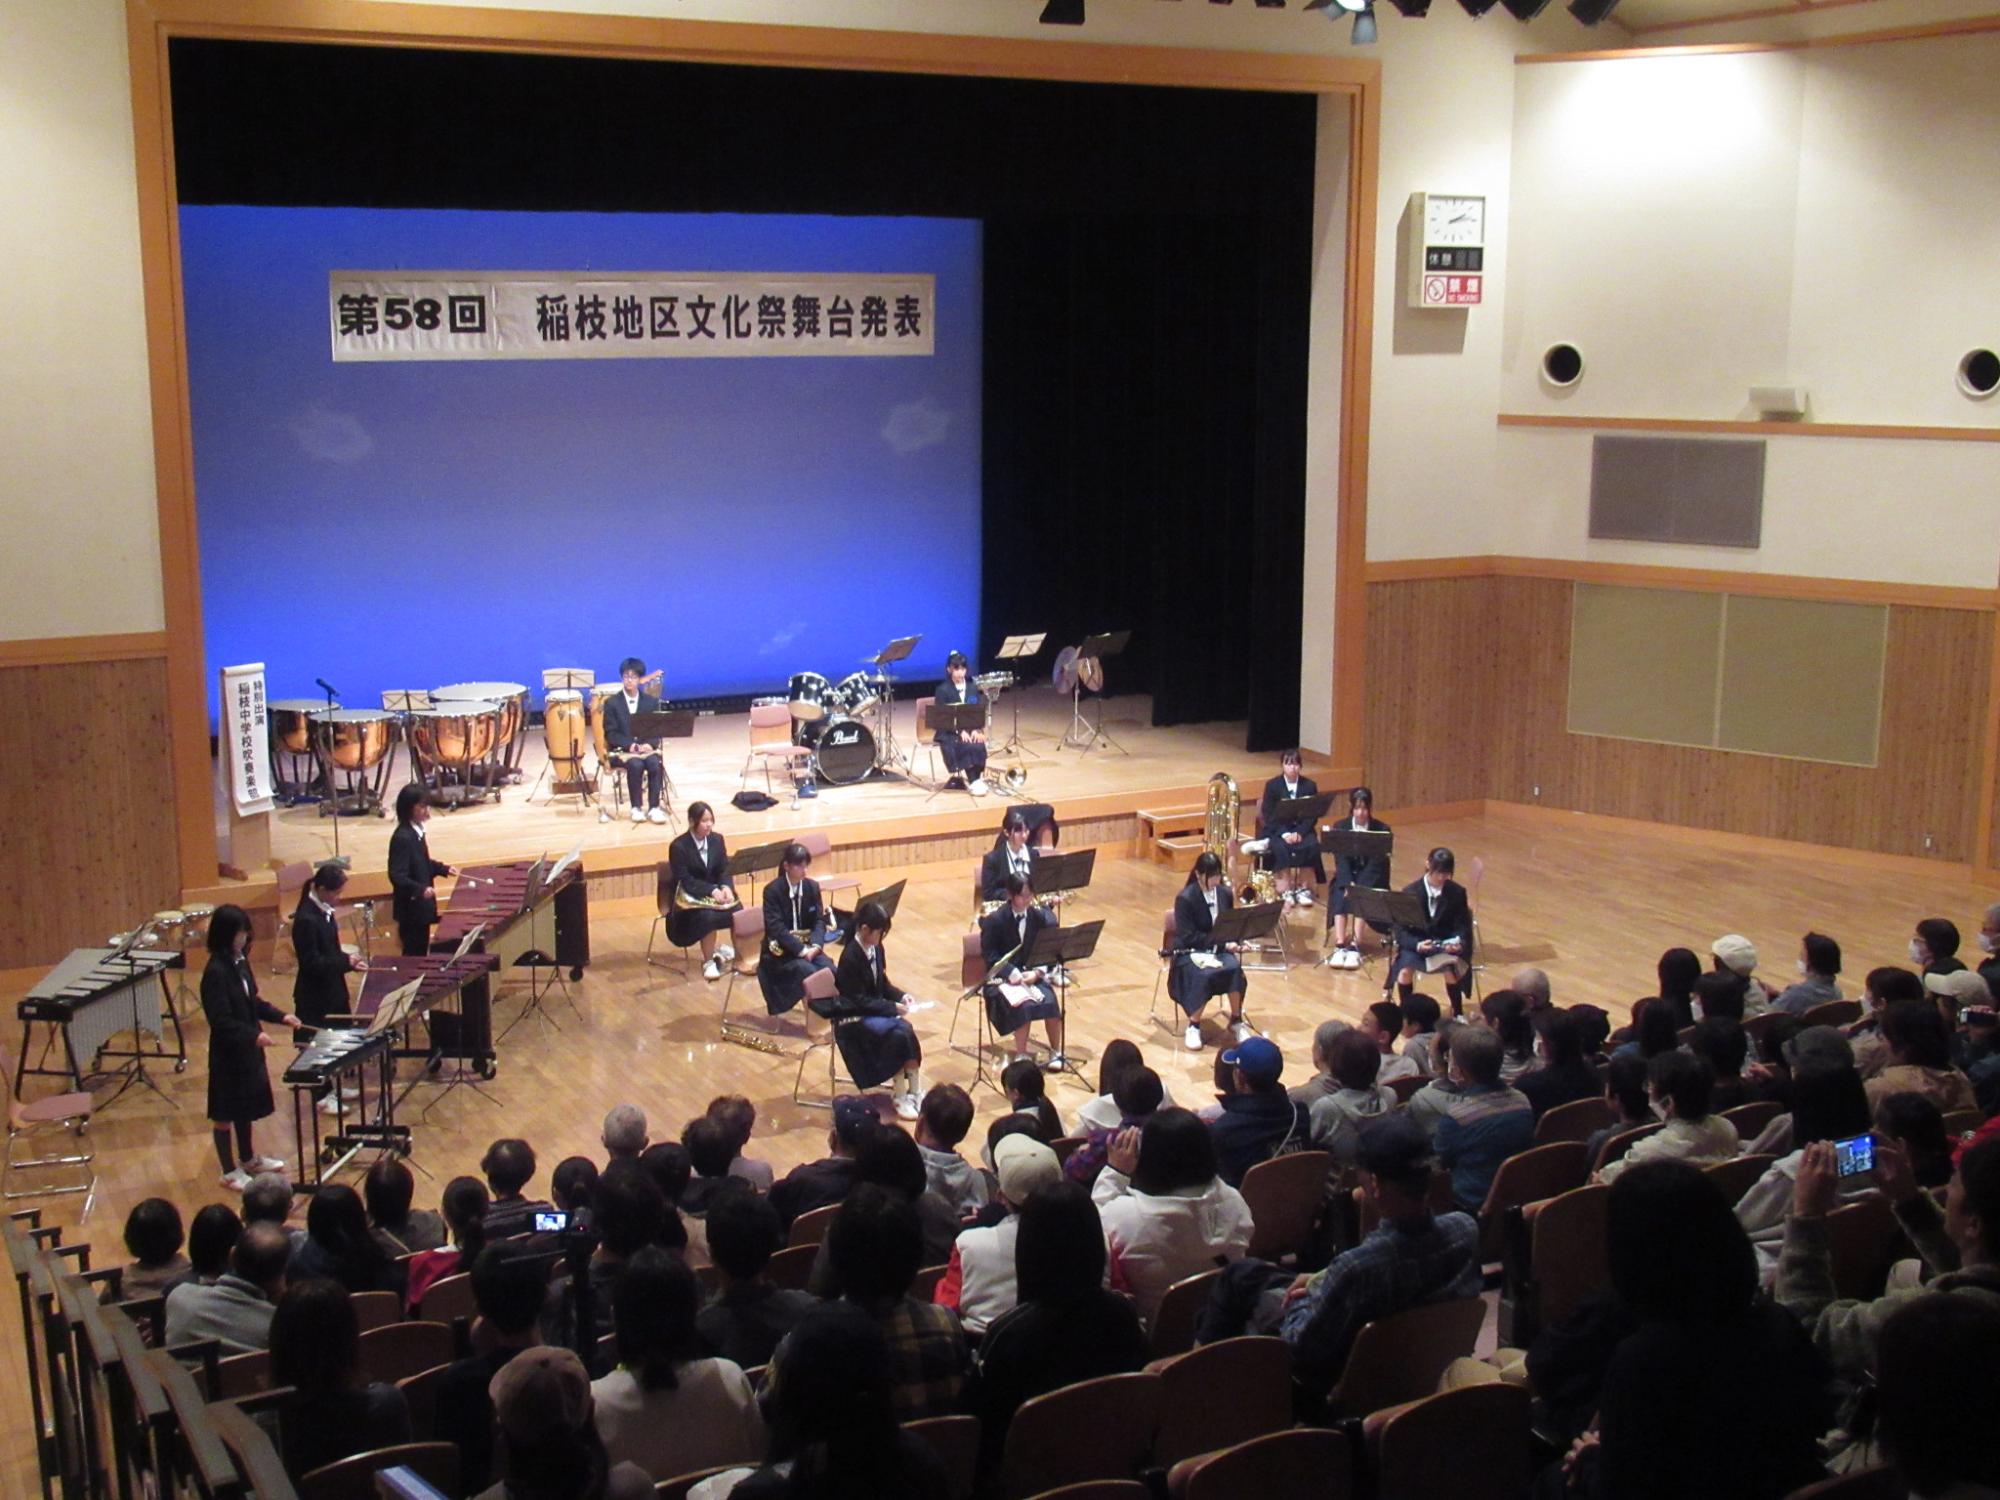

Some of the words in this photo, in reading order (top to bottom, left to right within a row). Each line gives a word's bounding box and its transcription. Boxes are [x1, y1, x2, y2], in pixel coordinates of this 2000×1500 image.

[338, 294, 486, 336] 第58回
[536, 295, 921, 341] 稲枝地区文化祭舞台発表
[253, 680, 265, 725] 特別出演
[238, 682, 260, 800] 稲枝中学校吹奏楽部
[830, 730, 858, 745] Pearl
